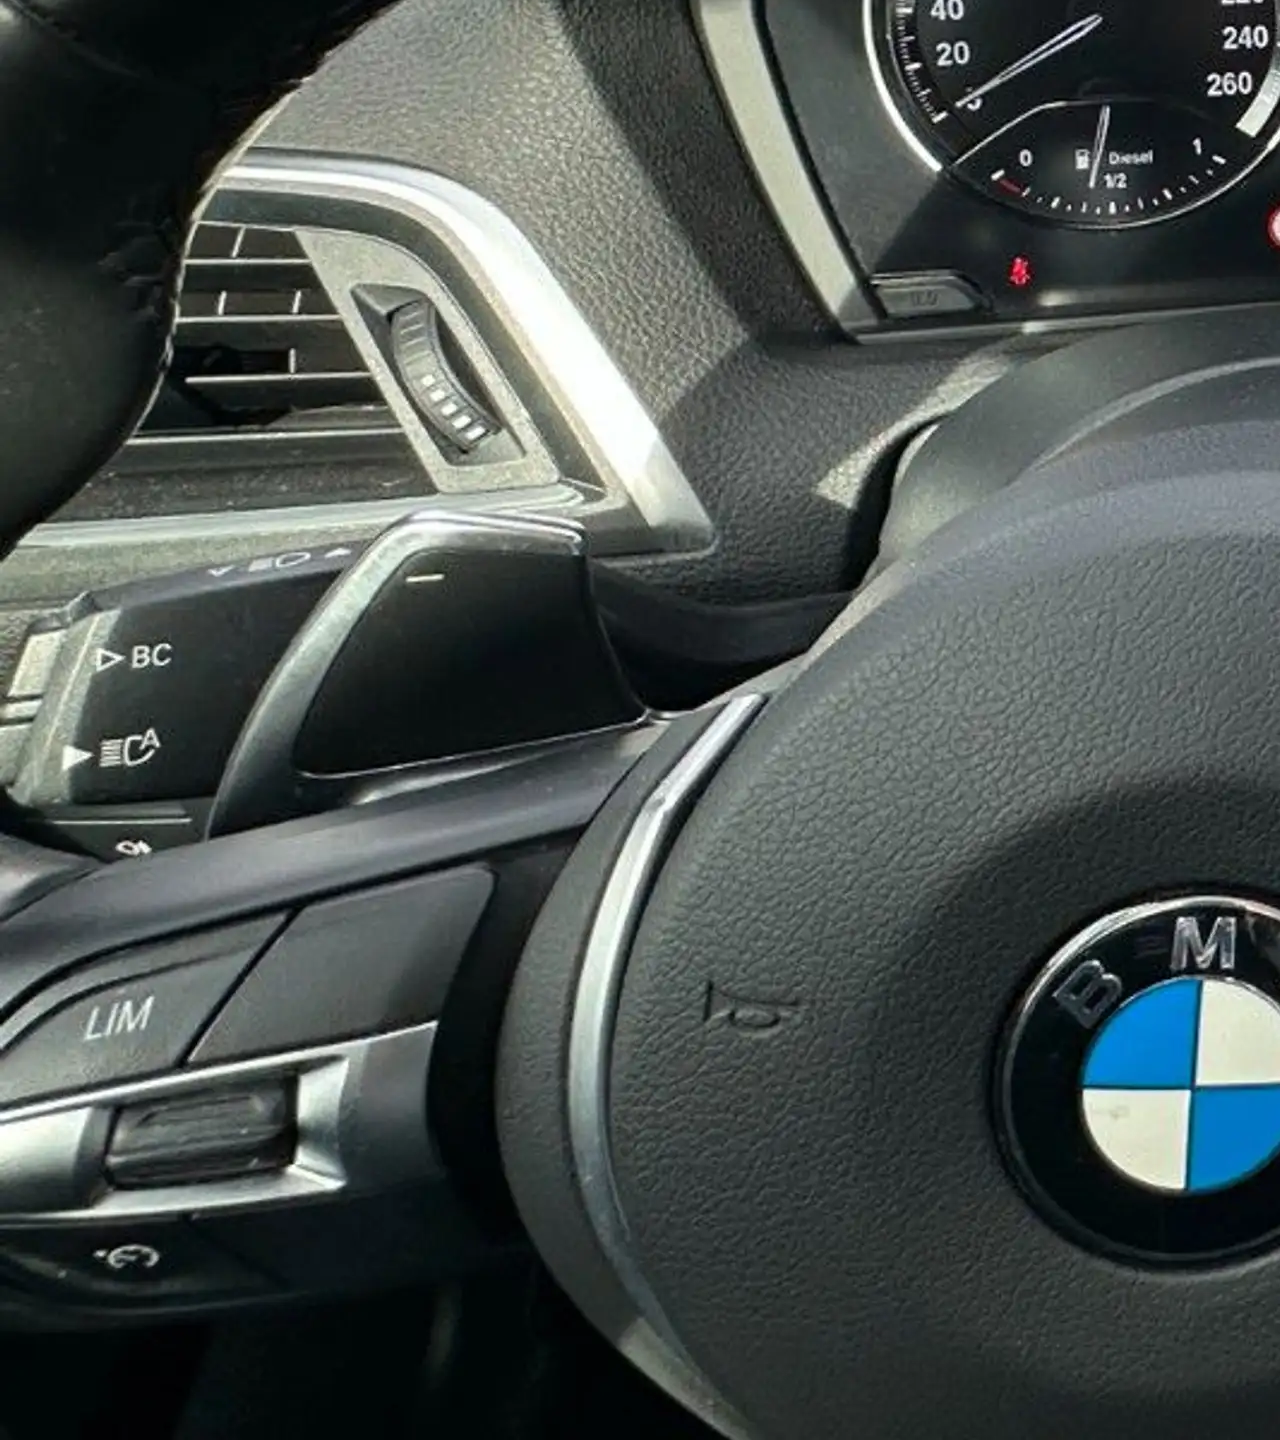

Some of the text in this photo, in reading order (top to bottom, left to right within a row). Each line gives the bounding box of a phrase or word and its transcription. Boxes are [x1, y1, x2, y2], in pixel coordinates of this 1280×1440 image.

[1222, 24, 1269, 50] 240
[936, 40, 970, 67] 20
[1206, 70, 1252, 97] 260
[1018, 148, 1033, 168] 0
[1108, 149, 1154, 166] Diesel
[1192, 137, 1203, 156] 1
[1104, 172, 1128, 189] 1/2
[131, 642, 173, 668] BC
[83, 996, 156, 1041] LIM
